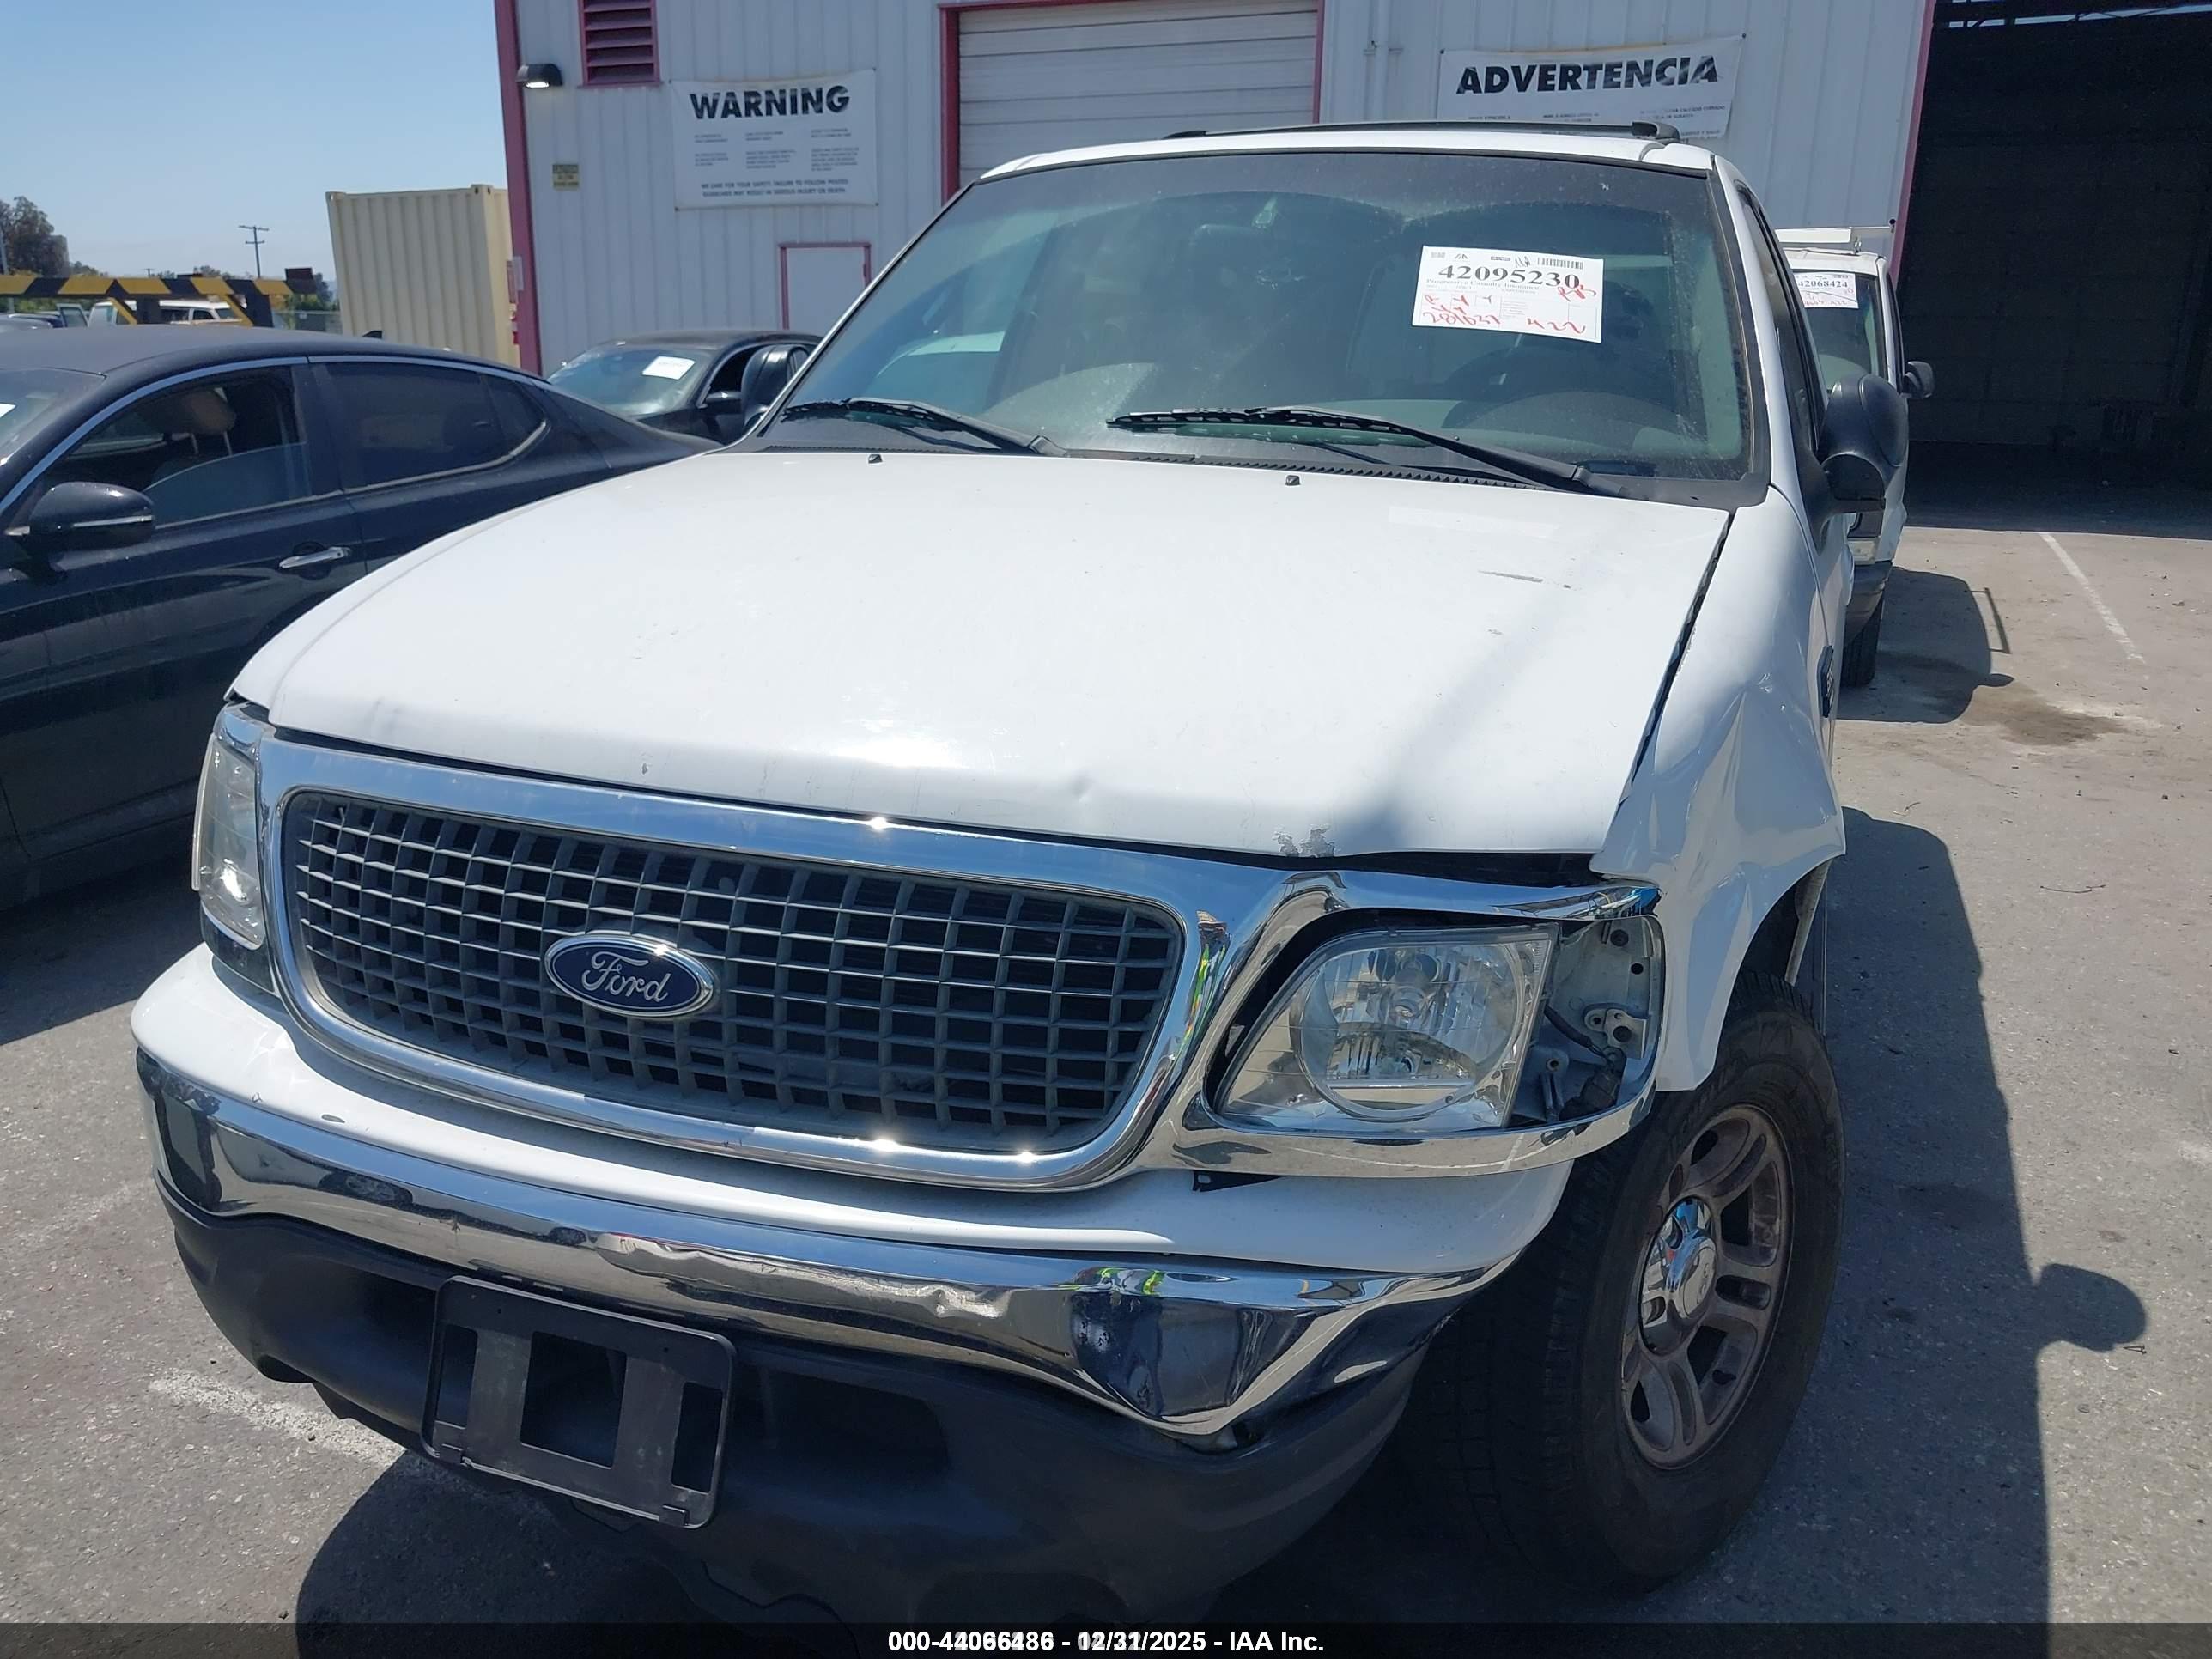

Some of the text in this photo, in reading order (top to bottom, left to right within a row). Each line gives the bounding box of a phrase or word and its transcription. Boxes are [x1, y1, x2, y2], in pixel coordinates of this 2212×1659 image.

[1455, 55, 1718, 94] ADVERTENCIA
[690, 85, 850, 119] WARNING
[1438, 265, 1579, 289] 42095230
[582, 951, 672, 1003] Ford
